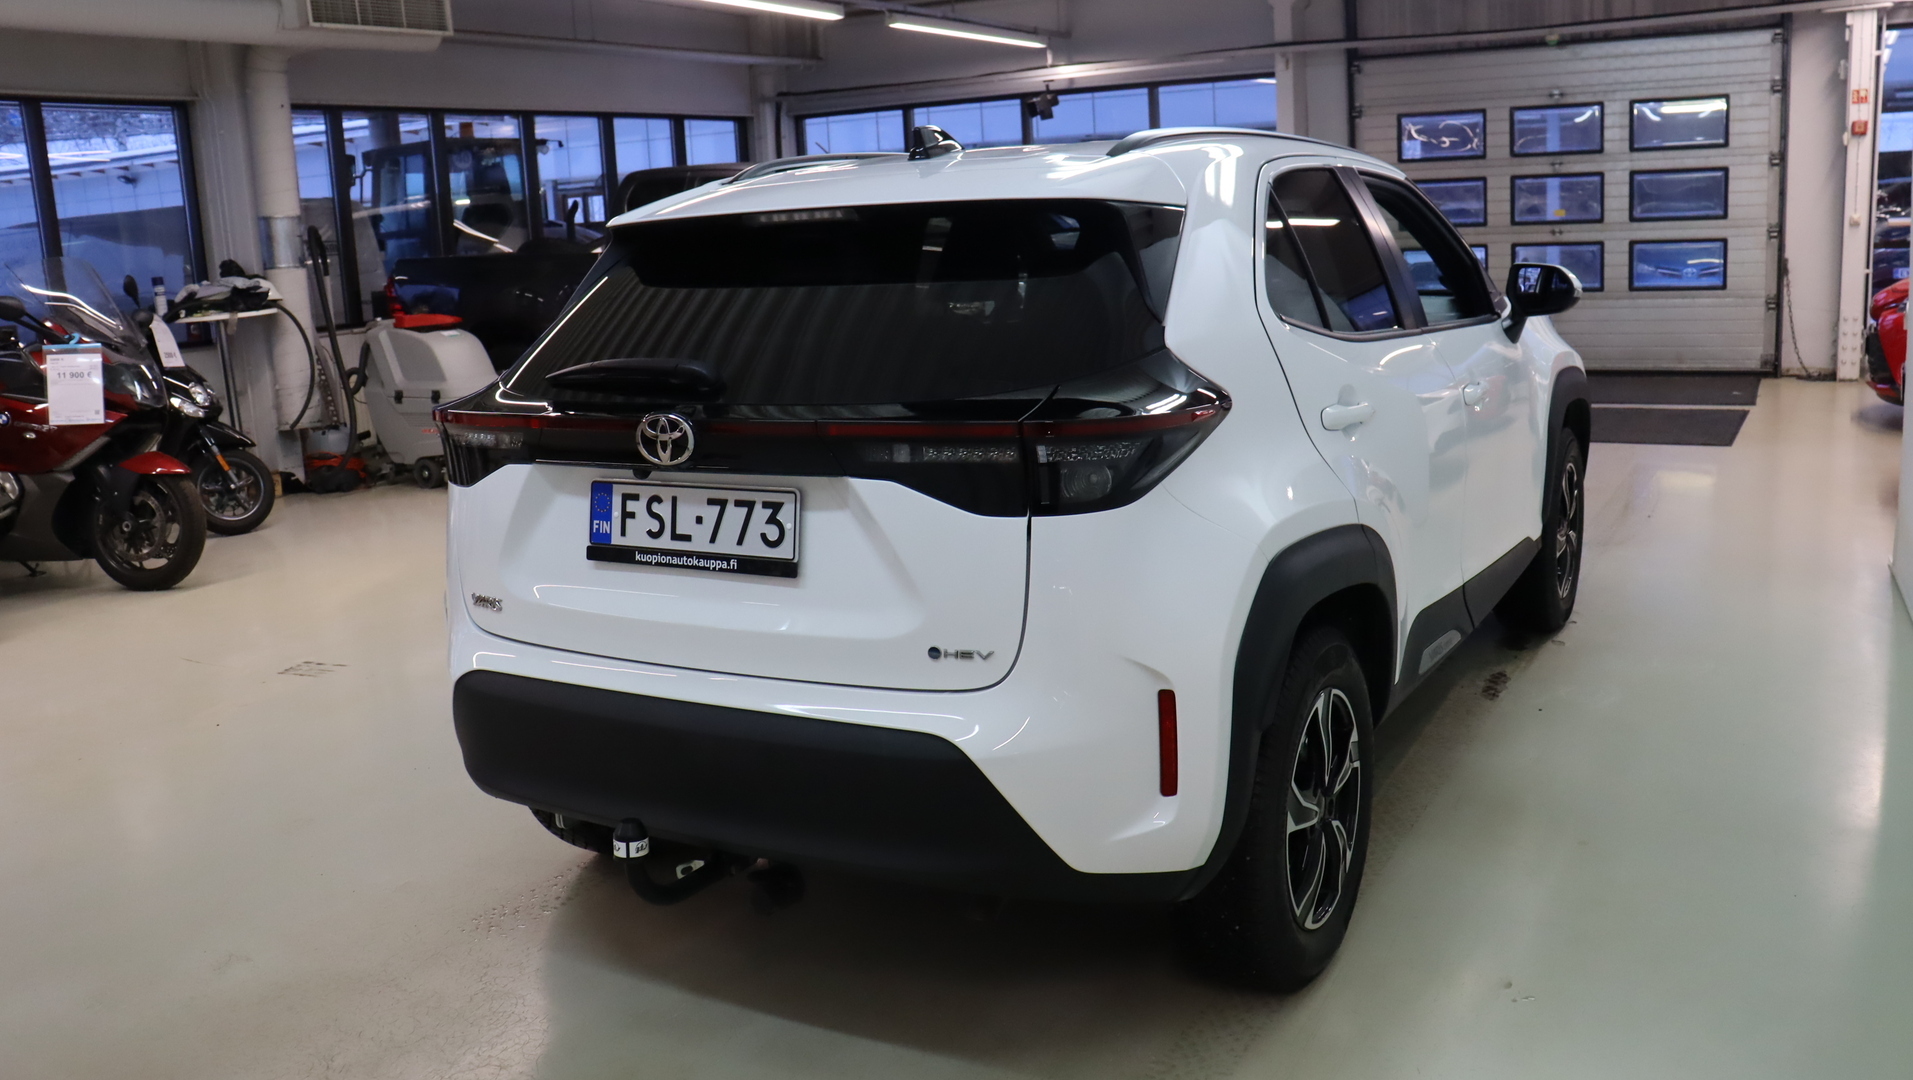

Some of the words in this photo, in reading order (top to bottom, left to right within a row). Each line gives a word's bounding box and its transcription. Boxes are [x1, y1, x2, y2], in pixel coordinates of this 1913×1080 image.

[69, 371, 85, 379] 900
[593, 520, 611, 534] FIN
[635, 551, 738, 571] kuopionautokauppa.fi
[943, 648, 995, 661] HEV
